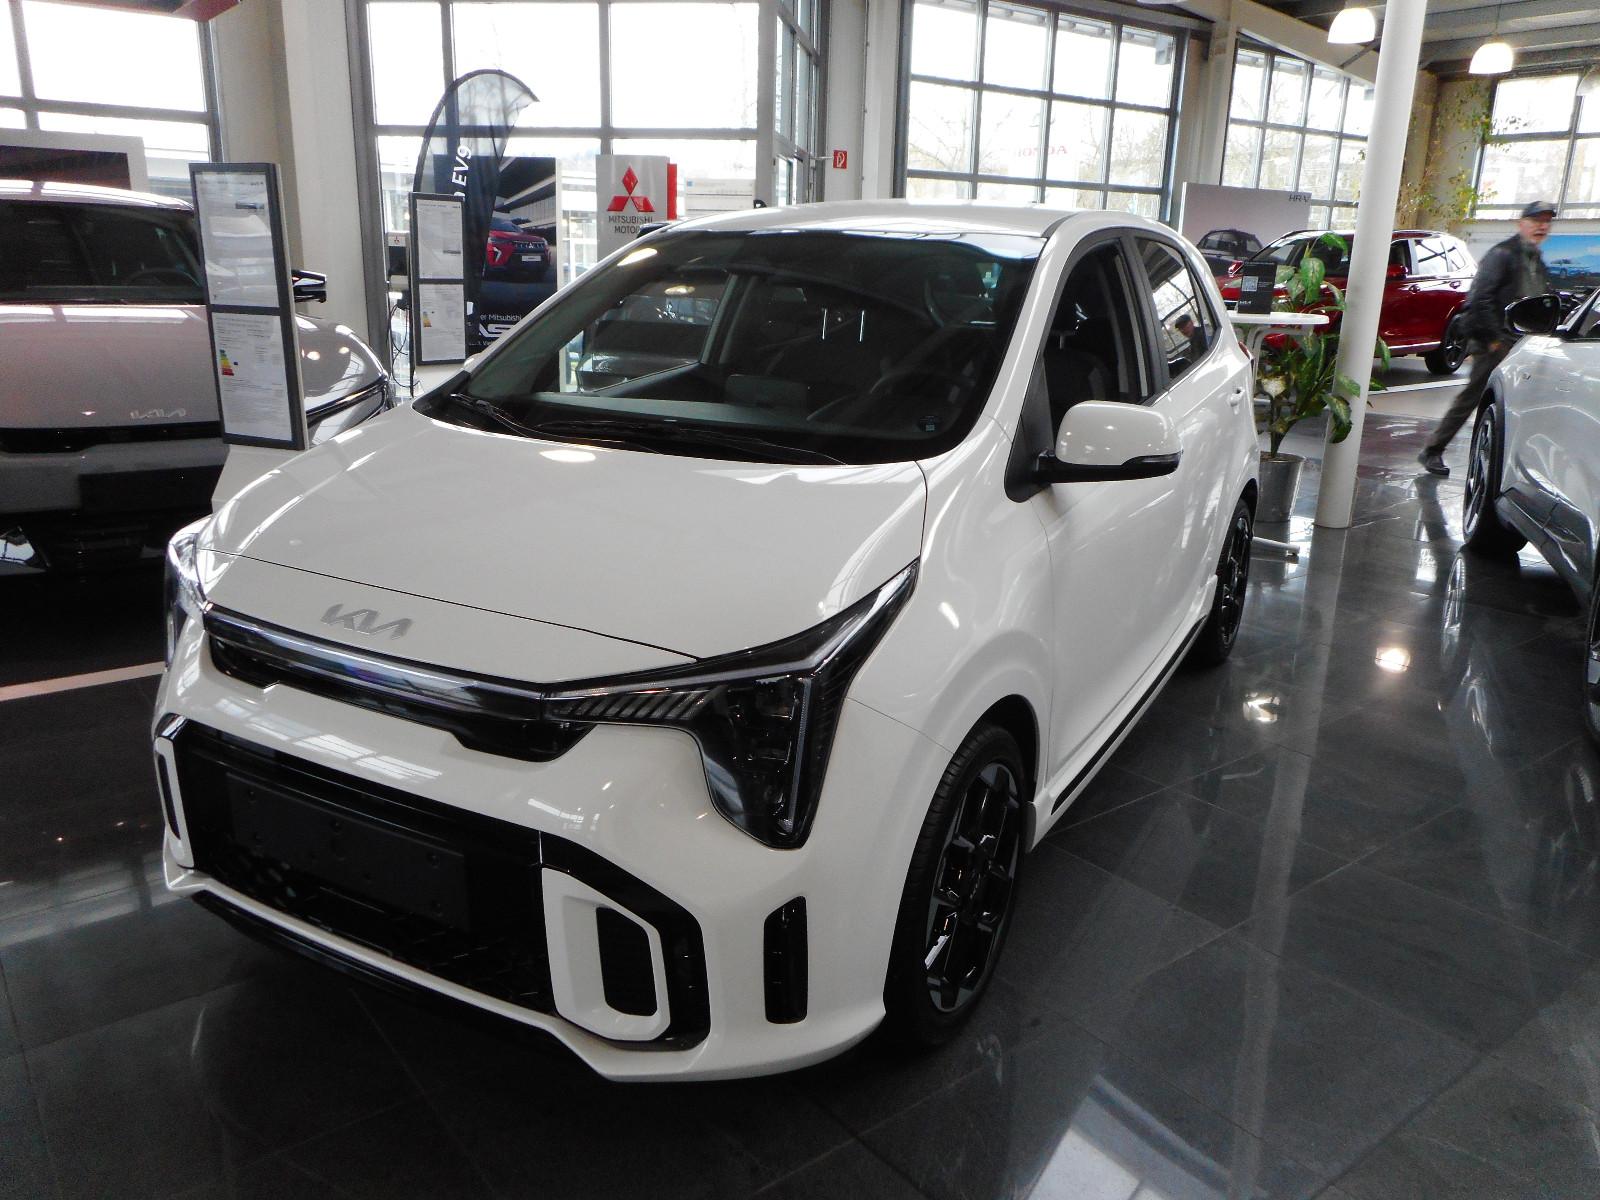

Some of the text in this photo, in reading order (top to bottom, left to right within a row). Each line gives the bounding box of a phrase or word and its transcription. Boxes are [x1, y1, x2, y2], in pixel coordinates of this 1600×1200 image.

[452, 145, 471, 186] EV9
[608, 215, 653, 224] MITSUBISHI
[320, 603, 414, 641] KIA
